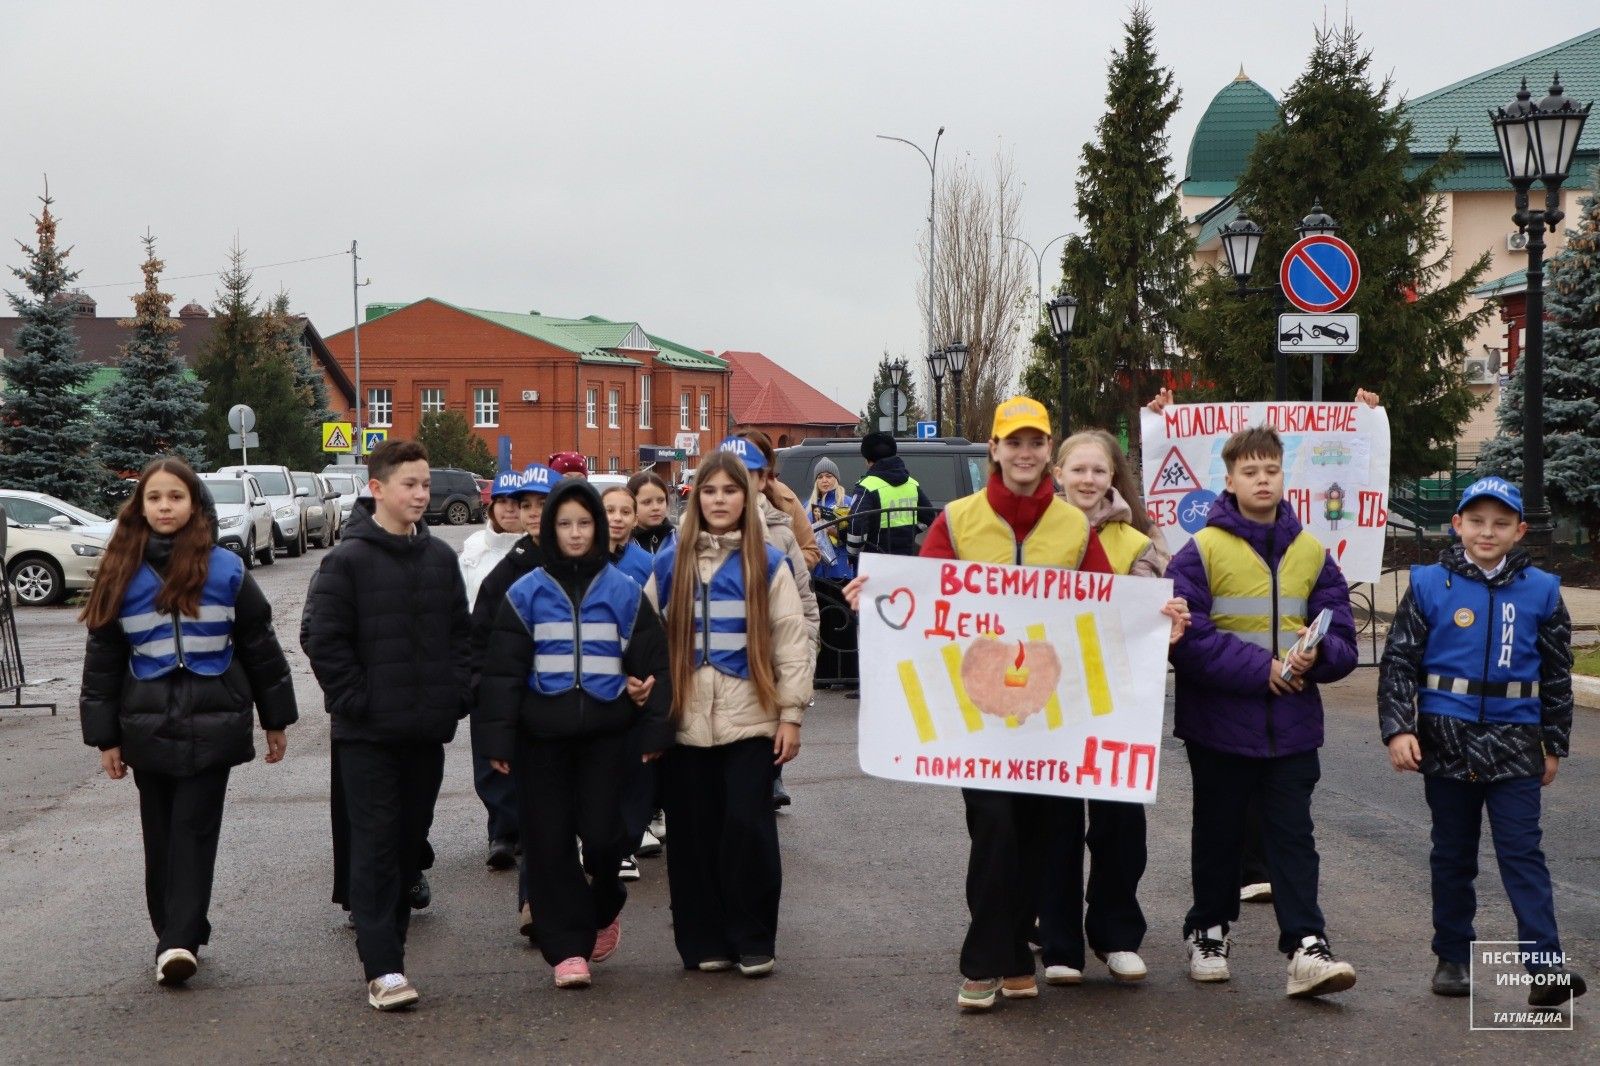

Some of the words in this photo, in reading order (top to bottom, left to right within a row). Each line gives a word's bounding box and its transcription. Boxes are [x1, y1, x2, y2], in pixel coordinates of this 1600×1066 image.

[1165, 405, 1250, 438] МОЛОДОЕ
[1267, 405, 1358, 432] ПОКОЛЕНИЕ
[1471, 479, 1509, 497] ЮИД
[924, 600, 1005, 640] ДЕНЬ
[1498, 602, 1516, 668] ЮИД
[915, 755, 1002, 780] ПАМЯТИ
[1007, 758, 1070, 783] ЖЕРТВ
[1076, 736, 1156, 791] ДТП
